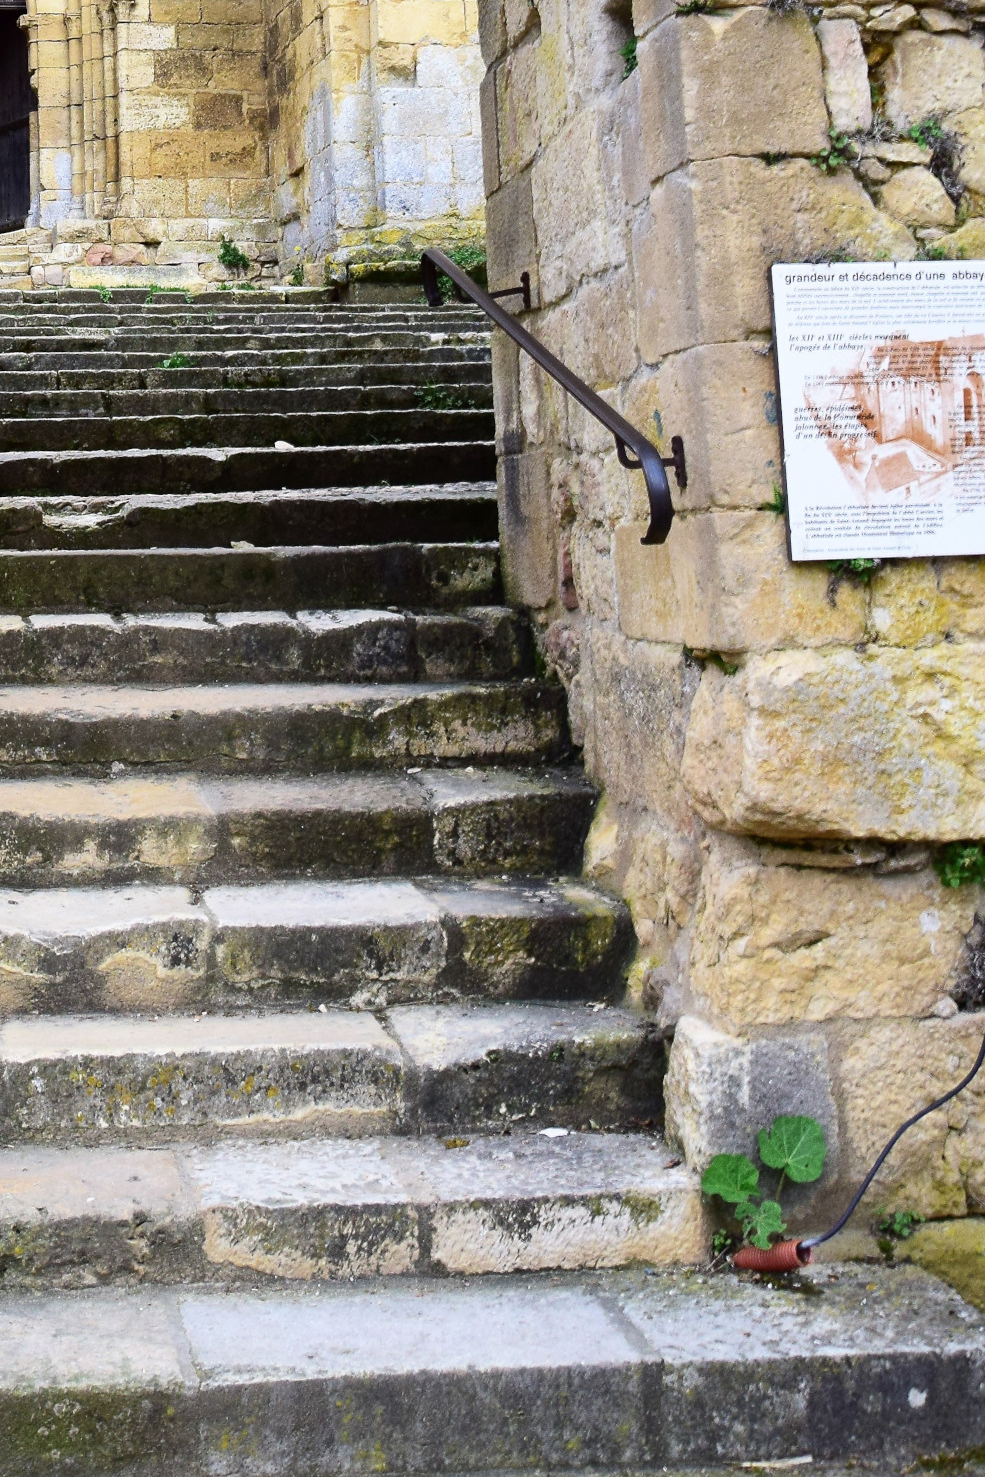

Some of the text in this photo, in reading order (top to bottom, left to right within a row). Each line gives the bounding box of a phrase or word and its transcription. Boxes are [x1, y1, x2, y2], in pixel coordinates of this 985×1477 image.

[785, 274, 834, 285] grandeur
[838, 273, 848, 282] et
[852, 272, 911, 282] décadence
[916, 270, 945, 280] d'une
[849, 332, 872, 340] siècles
[789, 344, 820, 352] l'apogée
